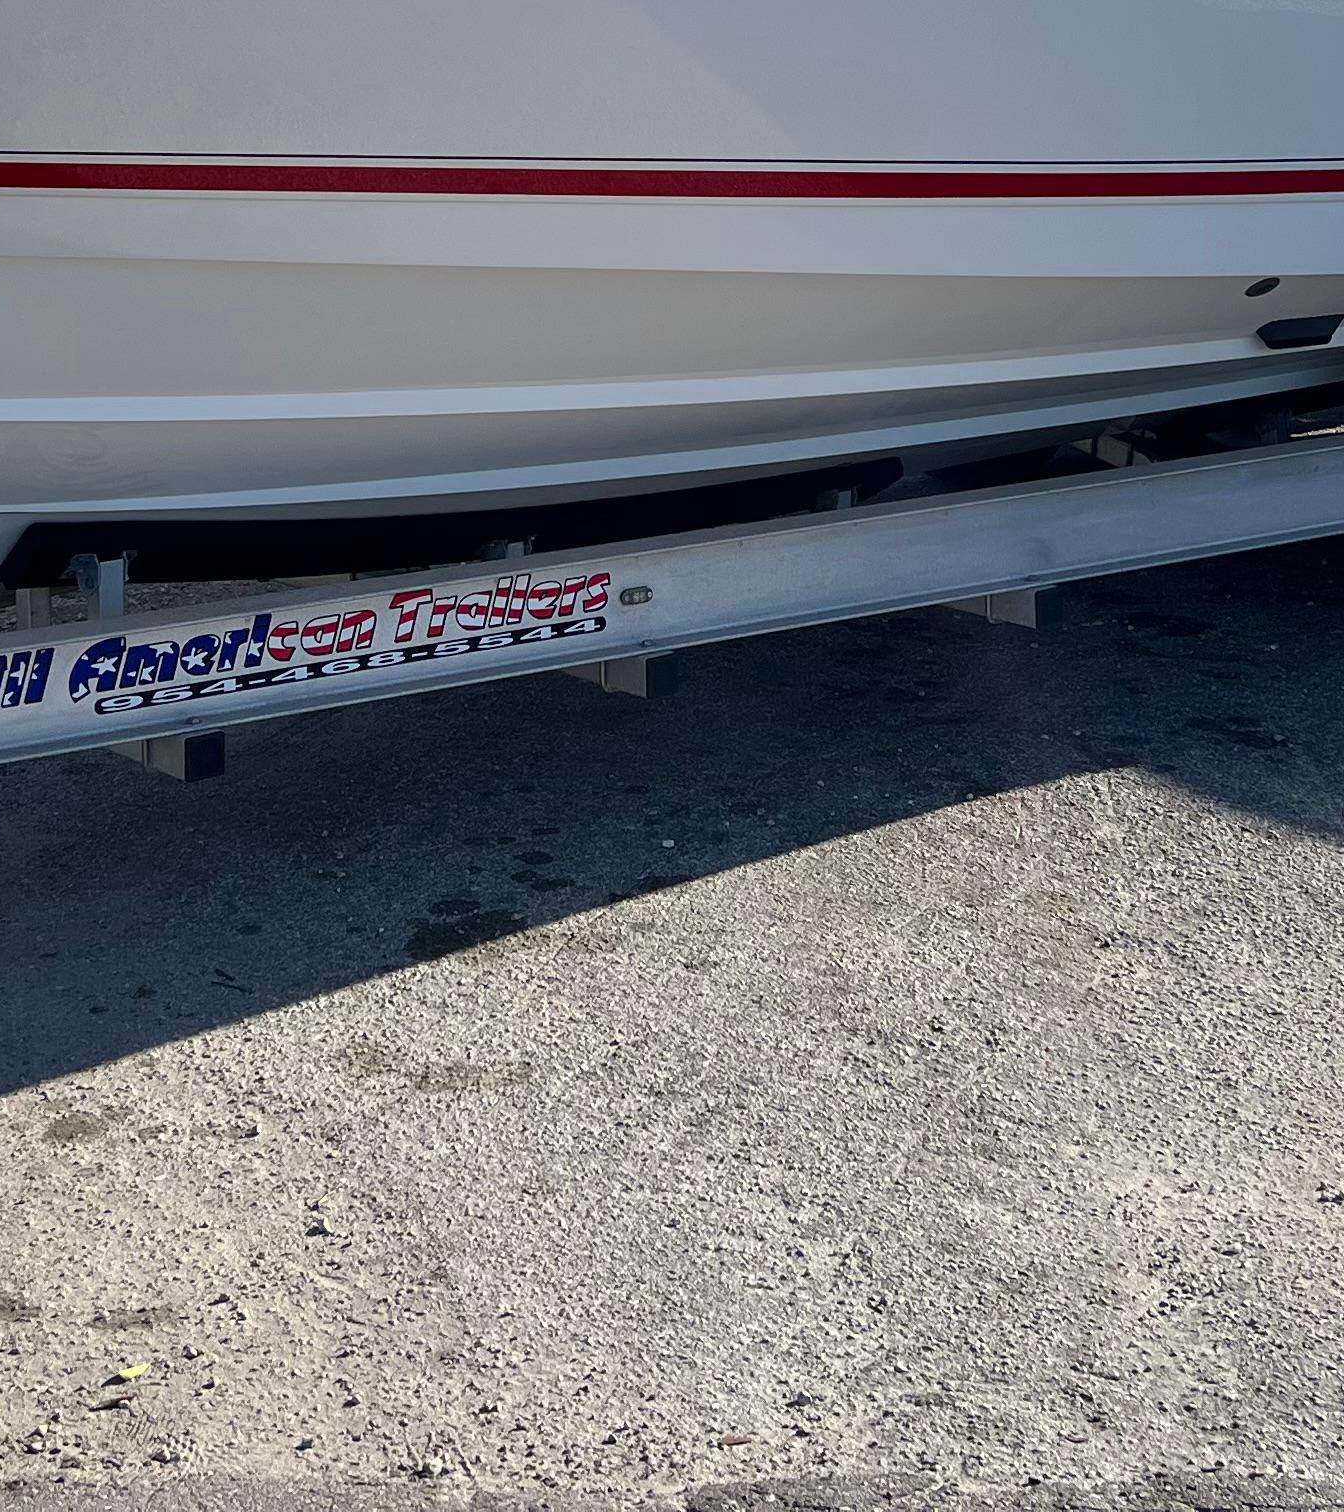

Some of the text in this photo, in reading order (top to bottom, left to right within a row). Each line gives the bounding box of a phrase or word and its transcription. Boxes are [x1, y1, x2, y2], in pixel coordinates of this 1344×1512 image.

[68, 609, 378, 704] American
[389, 572, 611, 643] Trailers
[99, 617, 602, 713] 954-468-5544
